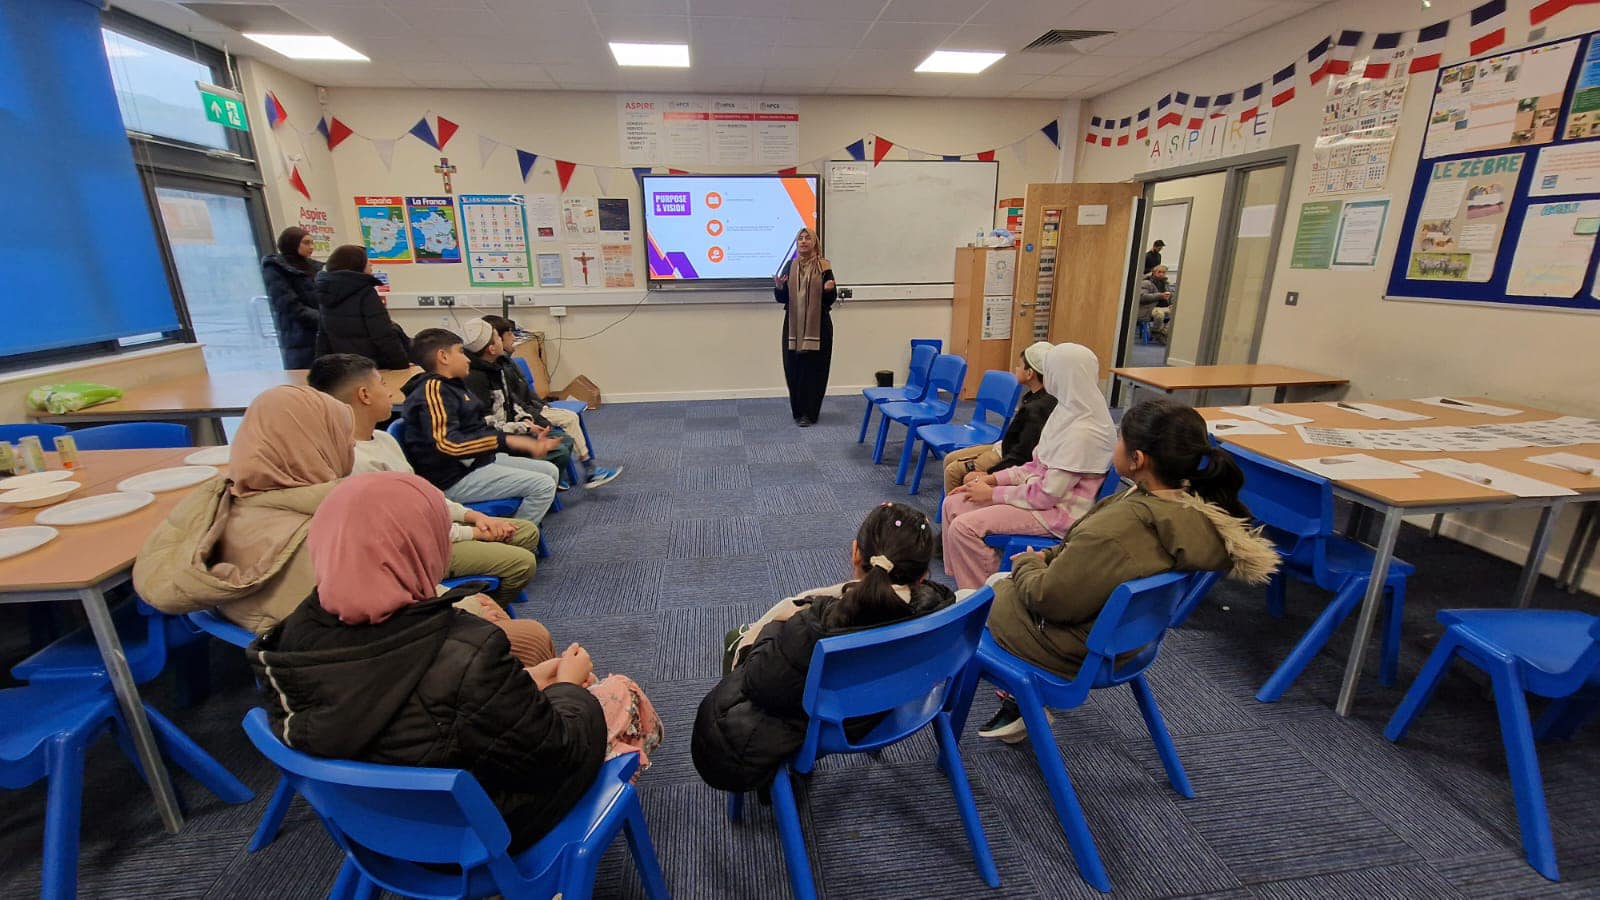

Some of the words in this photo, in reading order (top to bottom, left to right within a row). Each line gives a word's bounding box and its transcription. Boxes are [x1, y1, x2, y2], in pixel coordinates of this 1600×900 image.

[1433, 162, 1456, 180] LE
[656, 194, 686, 202] PURPOSE
[662, 204, 686, 212] VISION
[300, 207, 327, 222] Aspire
